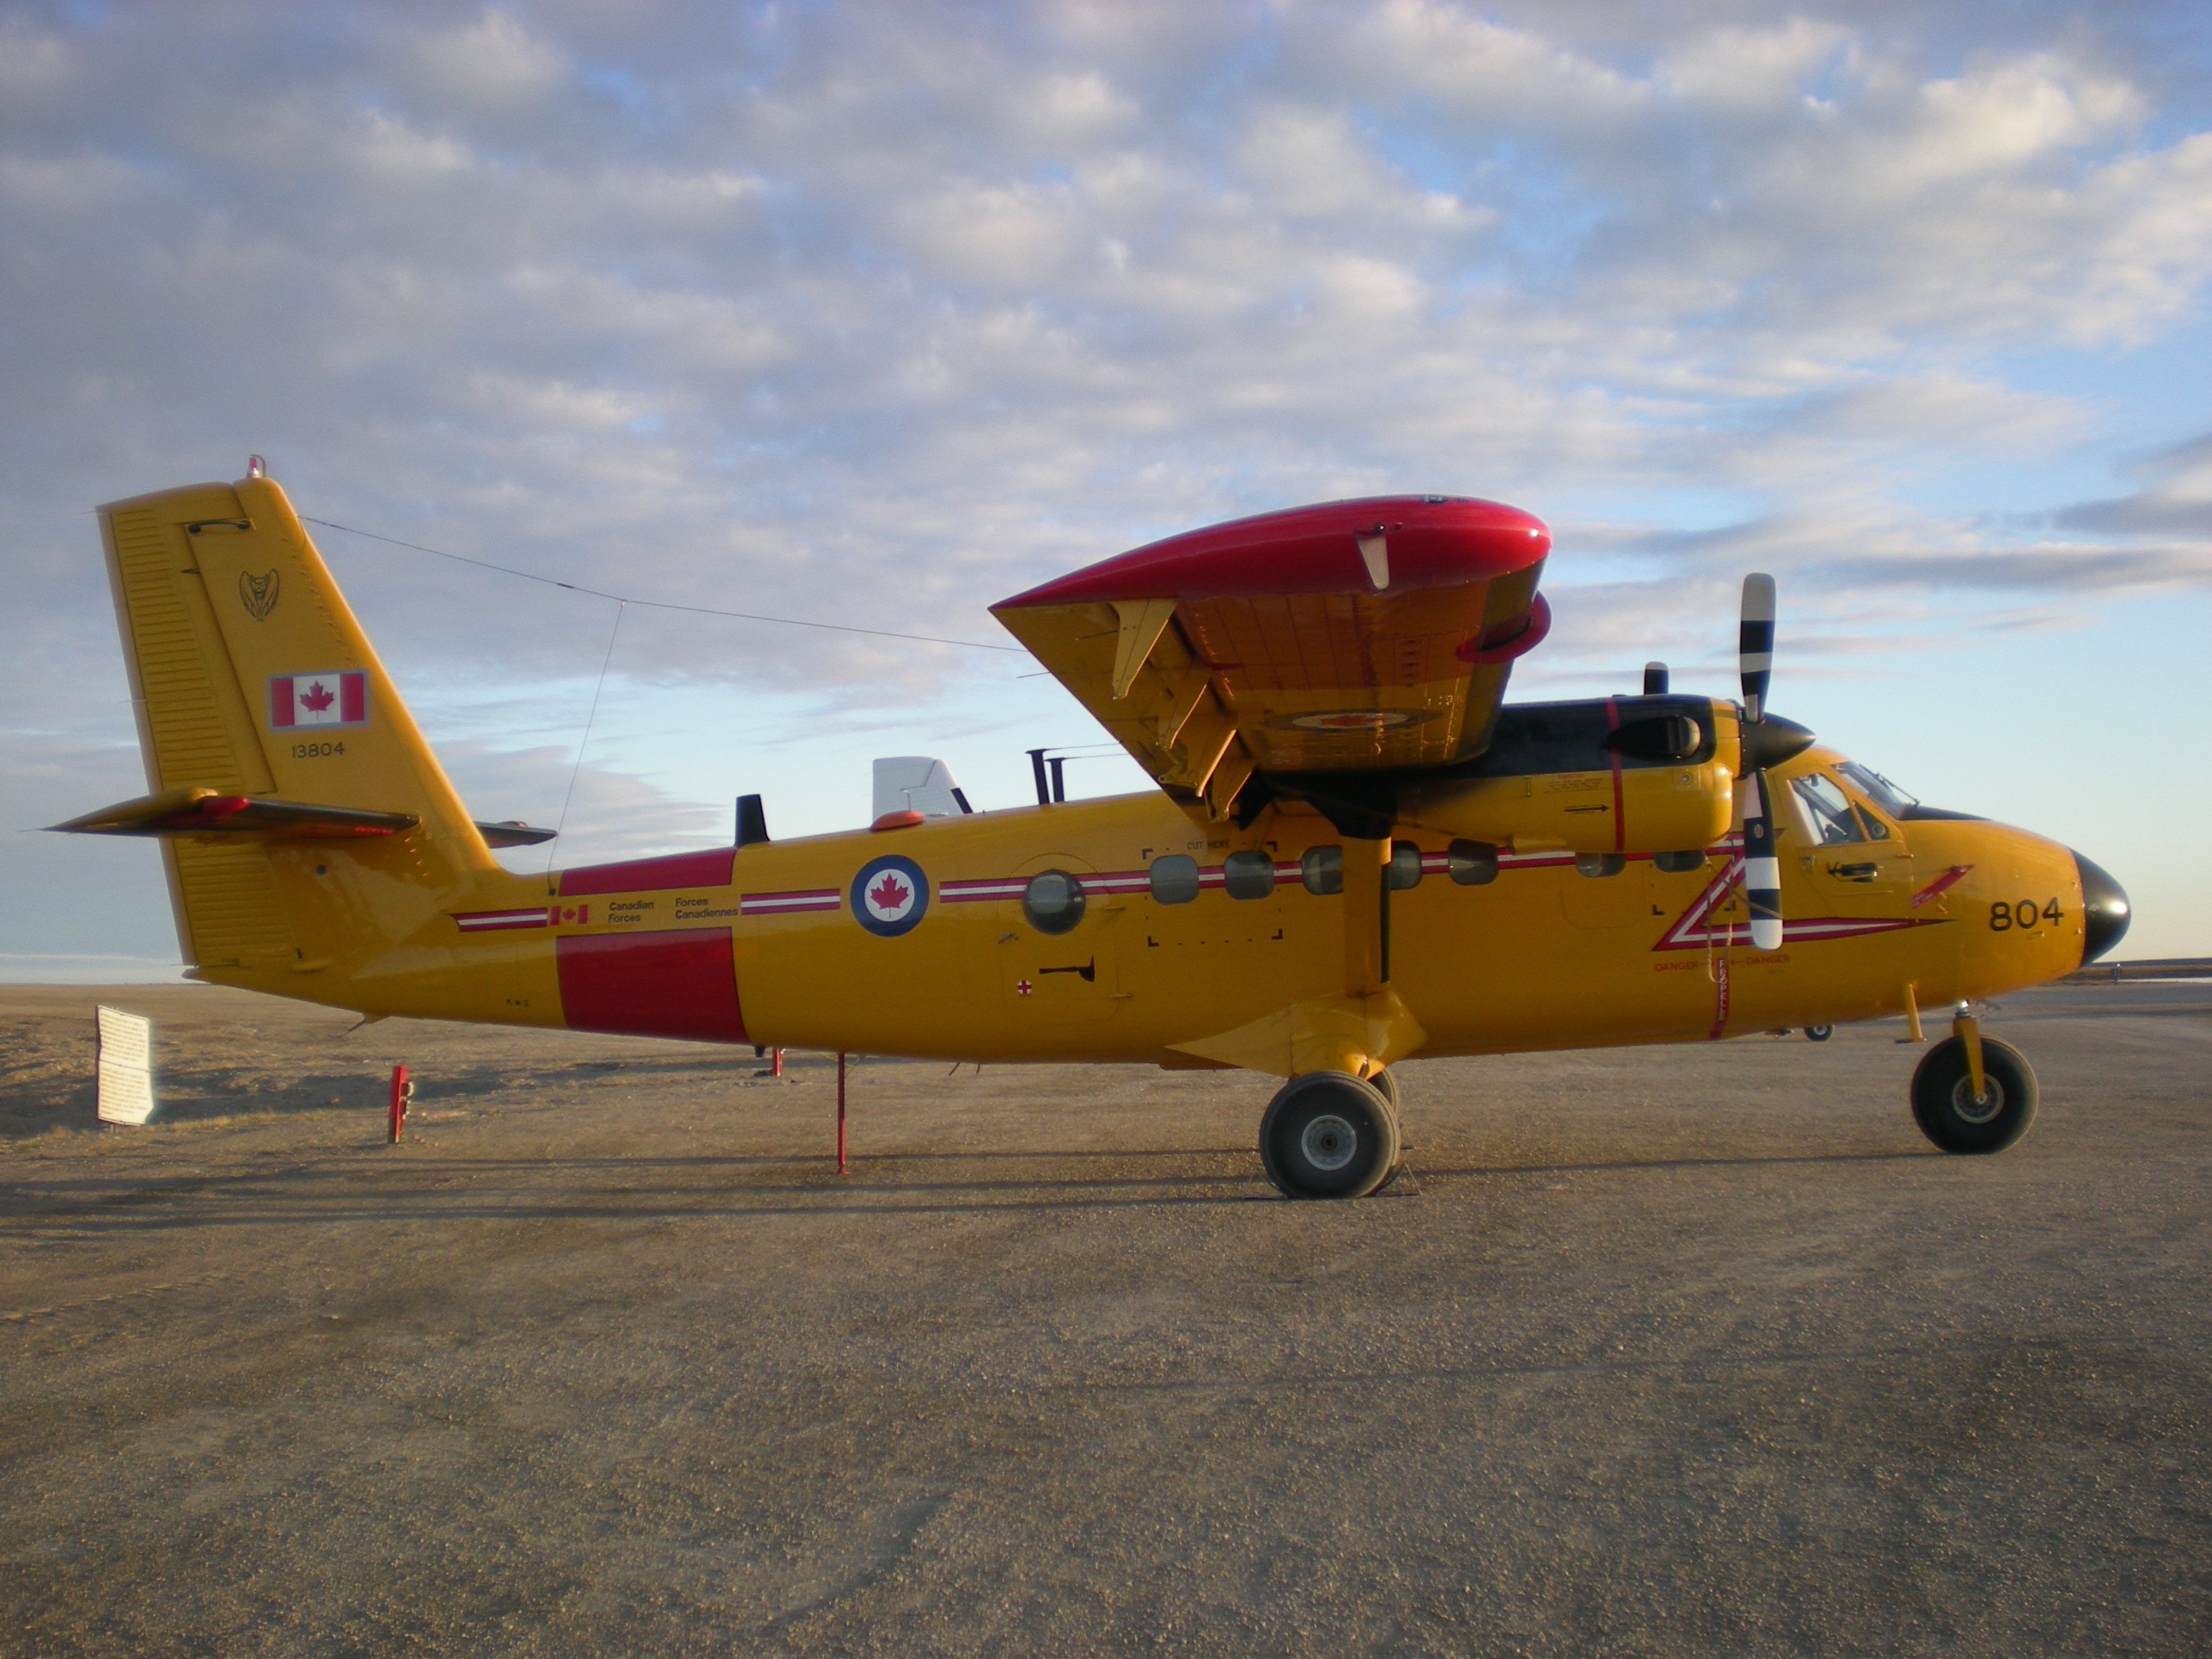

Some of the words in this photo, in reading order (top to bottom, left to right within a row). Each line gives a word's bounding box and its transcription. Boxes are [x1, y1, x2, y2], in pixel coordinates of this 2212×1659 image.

[292, 741, 345, 758] 13804
[1187, 841, 1203, 850] CUT
[1208, 840, 1230, 849] HERE
[608, 900, 654, 911] Canadian
[675, 897, 709, 907] Forces
[608, 913, 641, 922] Forces
[675, 907, 738, 920] Canadiennes
[1990, 896, 2064, 932] 804
[1745, 954, 1791, 966] DANGER
[1655, 961, 1699, 971] DANGER
